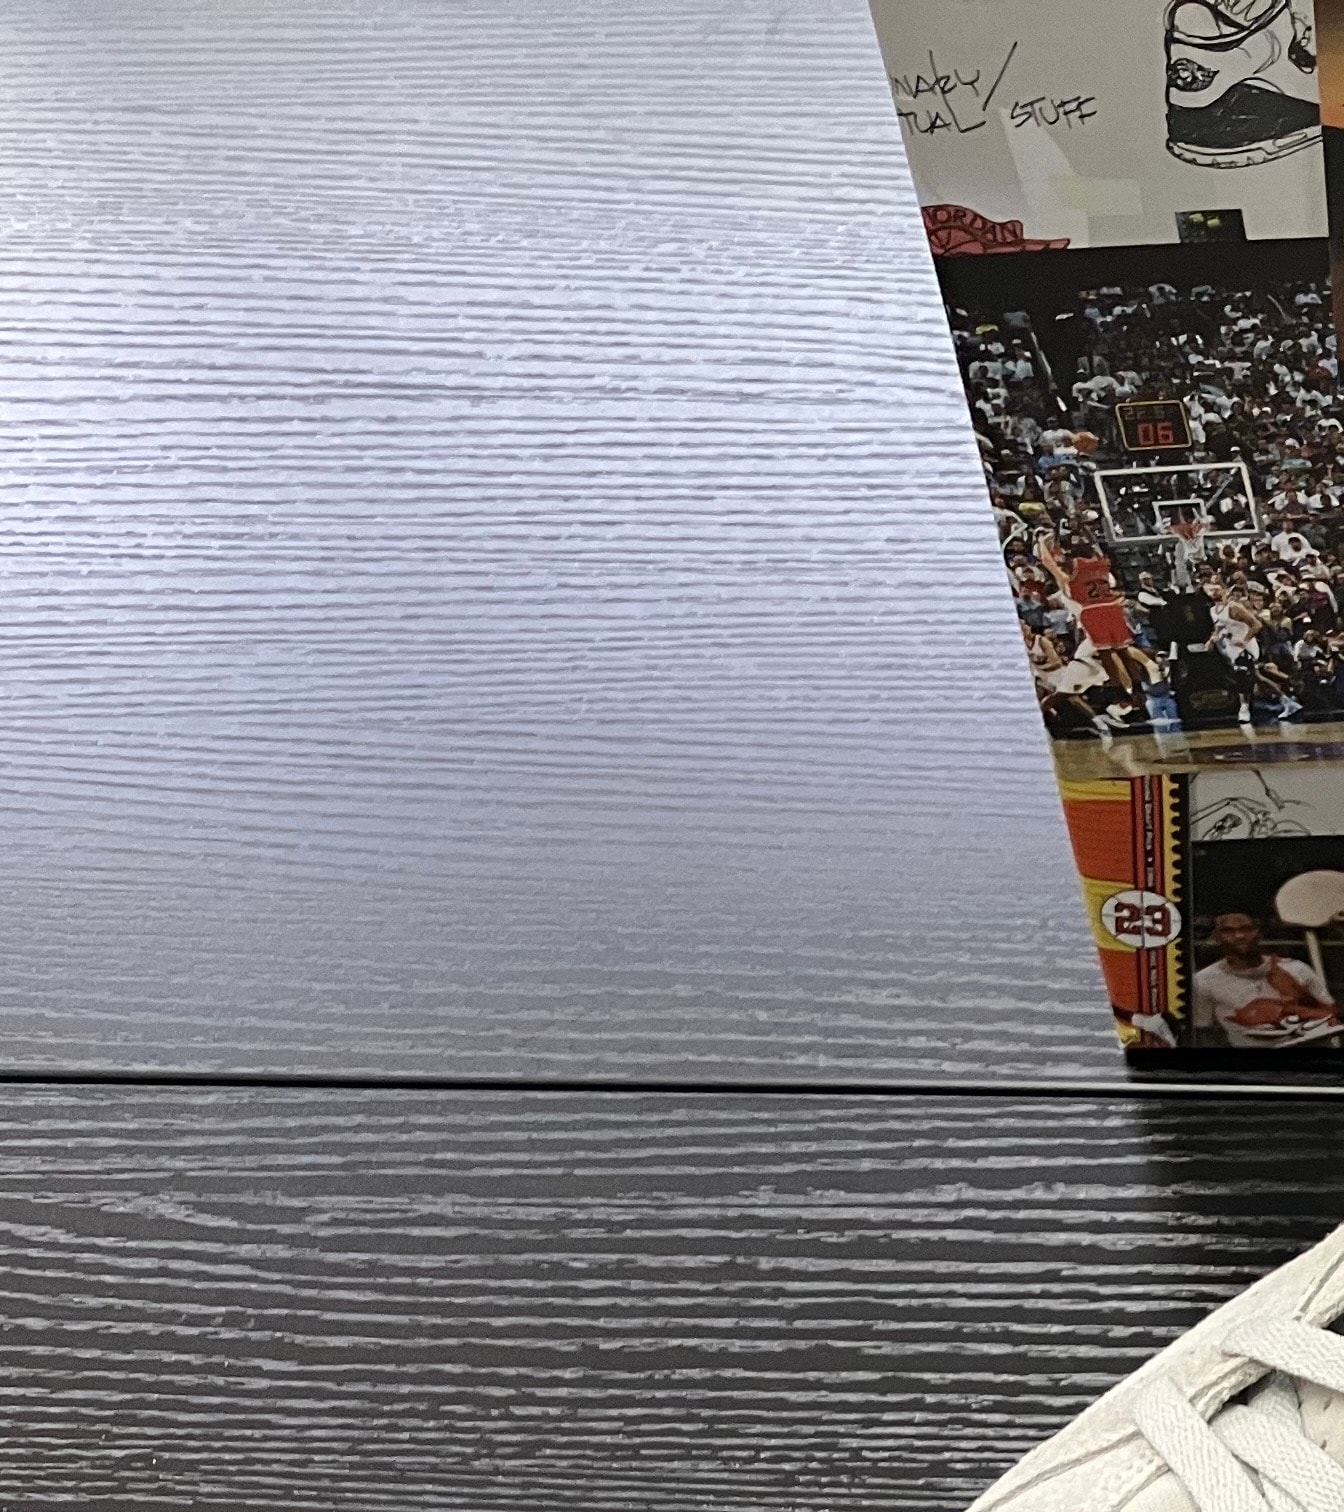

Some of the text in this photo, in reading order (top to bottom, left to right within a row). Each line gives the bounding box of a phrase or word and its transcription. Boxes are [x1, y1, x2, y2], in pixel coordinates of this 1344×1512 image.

[1010, 96, 1097, 129] STUFF
[1137, 421, 1174, 446] 06
[1115, 902, 1172, 938] 23
